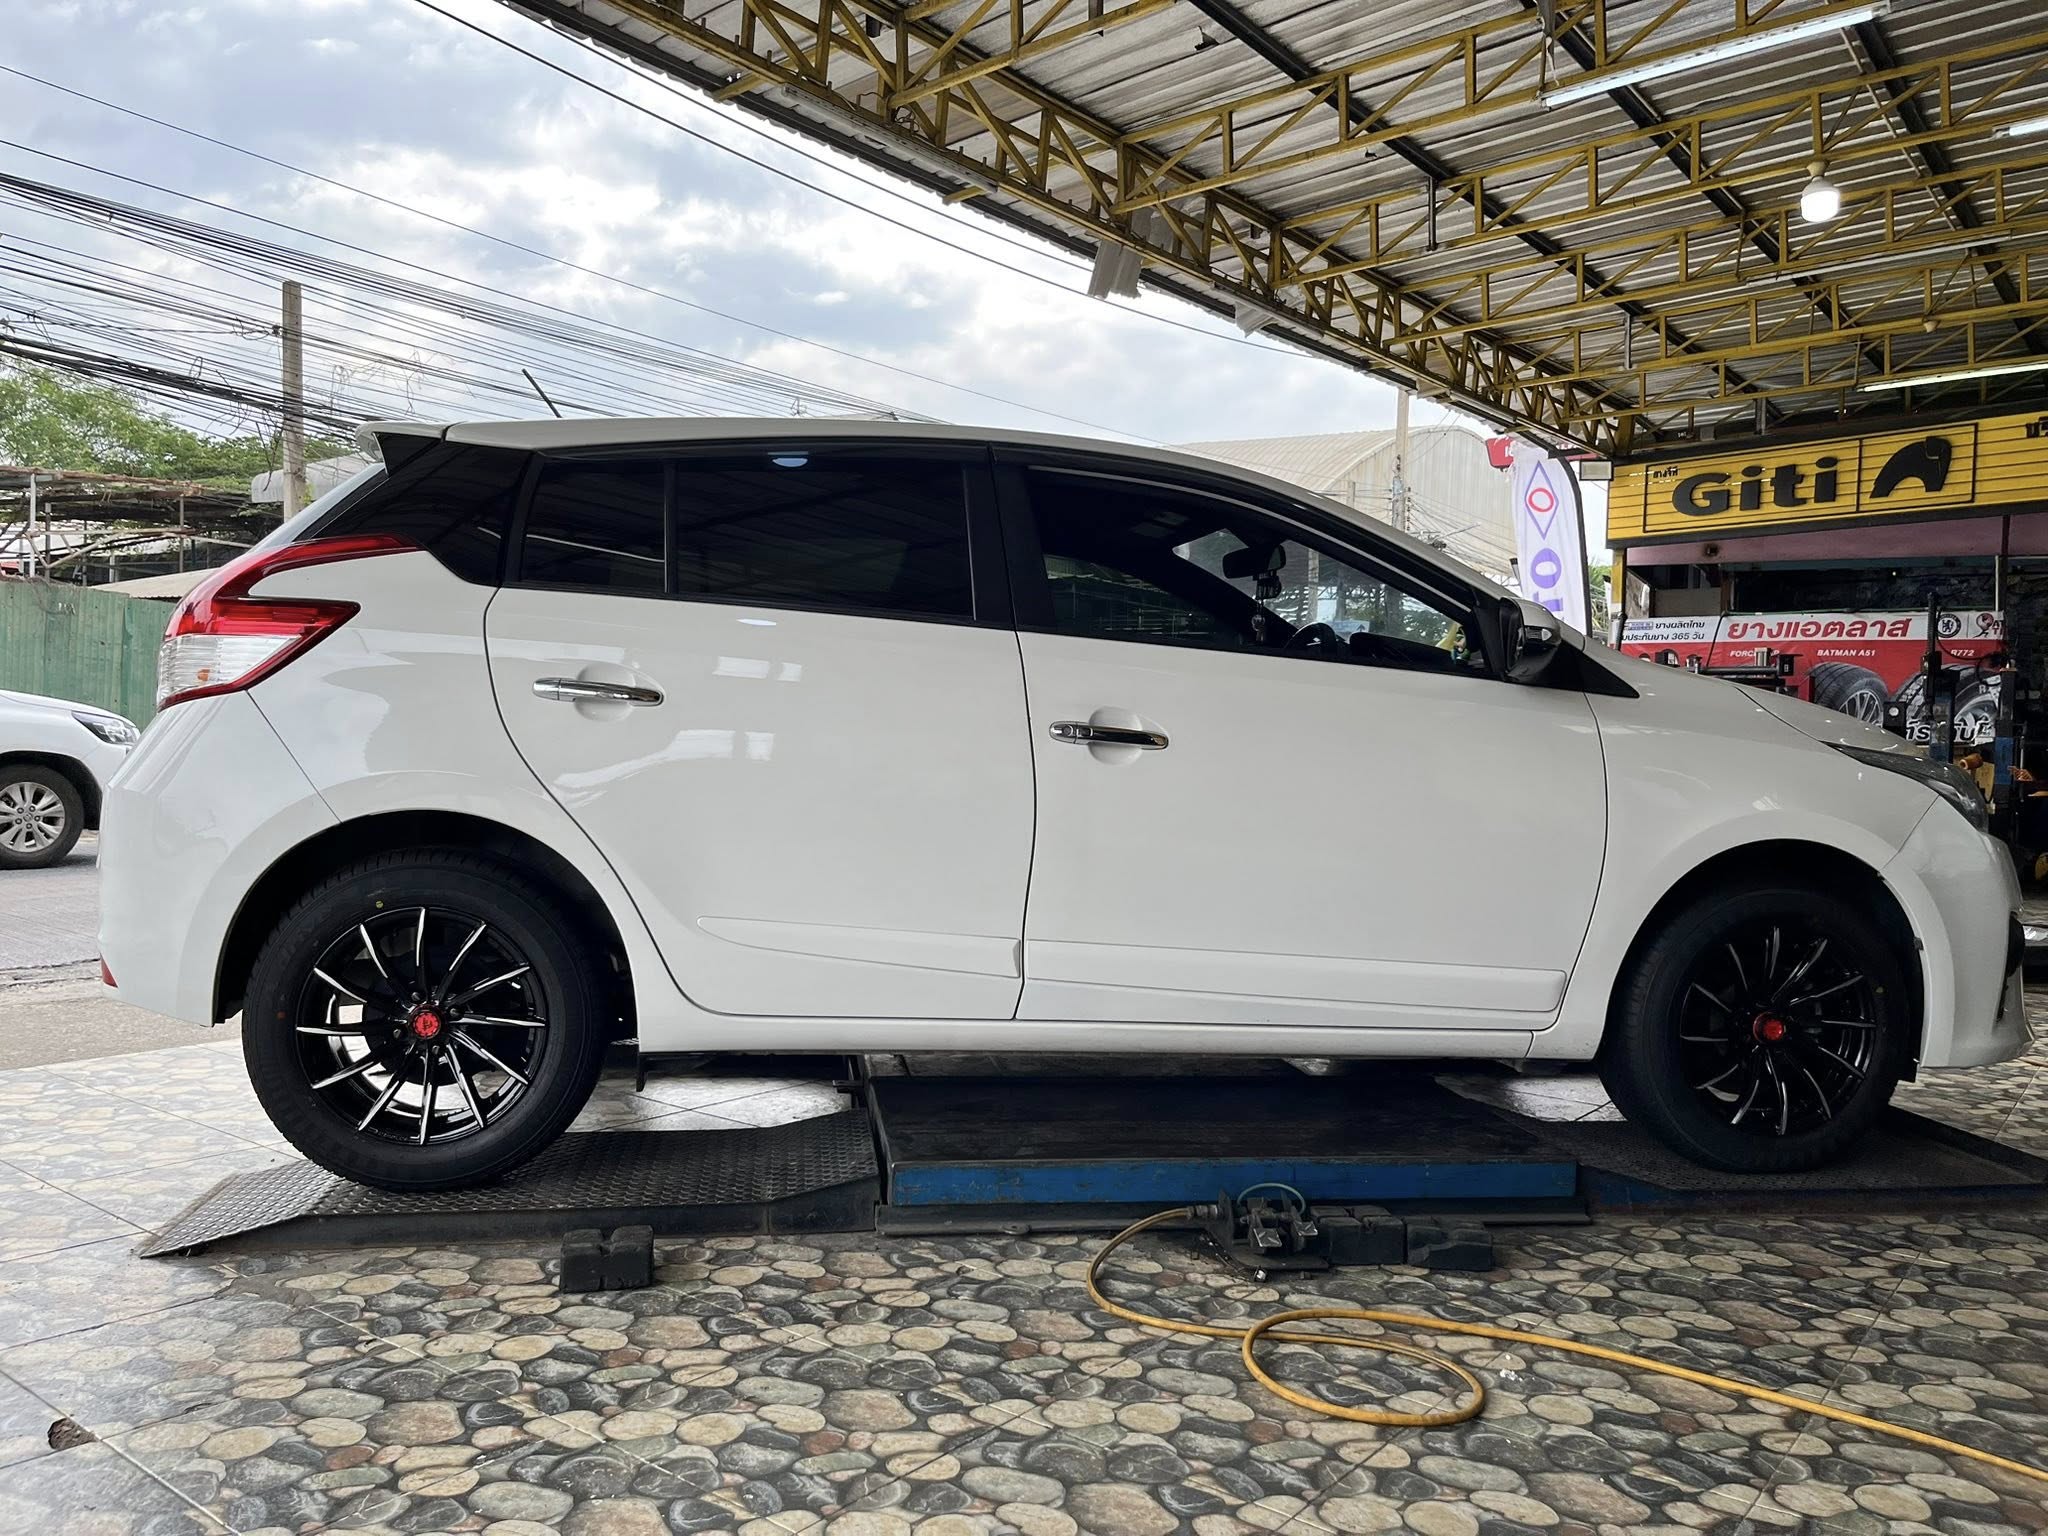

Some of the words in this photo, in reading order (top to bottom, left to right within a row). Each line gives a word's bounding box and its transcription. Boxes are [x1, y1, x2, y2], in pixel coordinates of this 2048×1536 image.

[1672, 456, 1838, 516] Giti
[1655, 620, 1705, 629] ยางผลิตไทย
[1727, 618, 1912, 639] ยางแอตลาส
[1671, 632, 1690, 640] 365
[1691, 632, 1705, 640] วัน
[1817, 649, 1857, 657] BATMAN
[1859, 649, 1876, 657] A51
